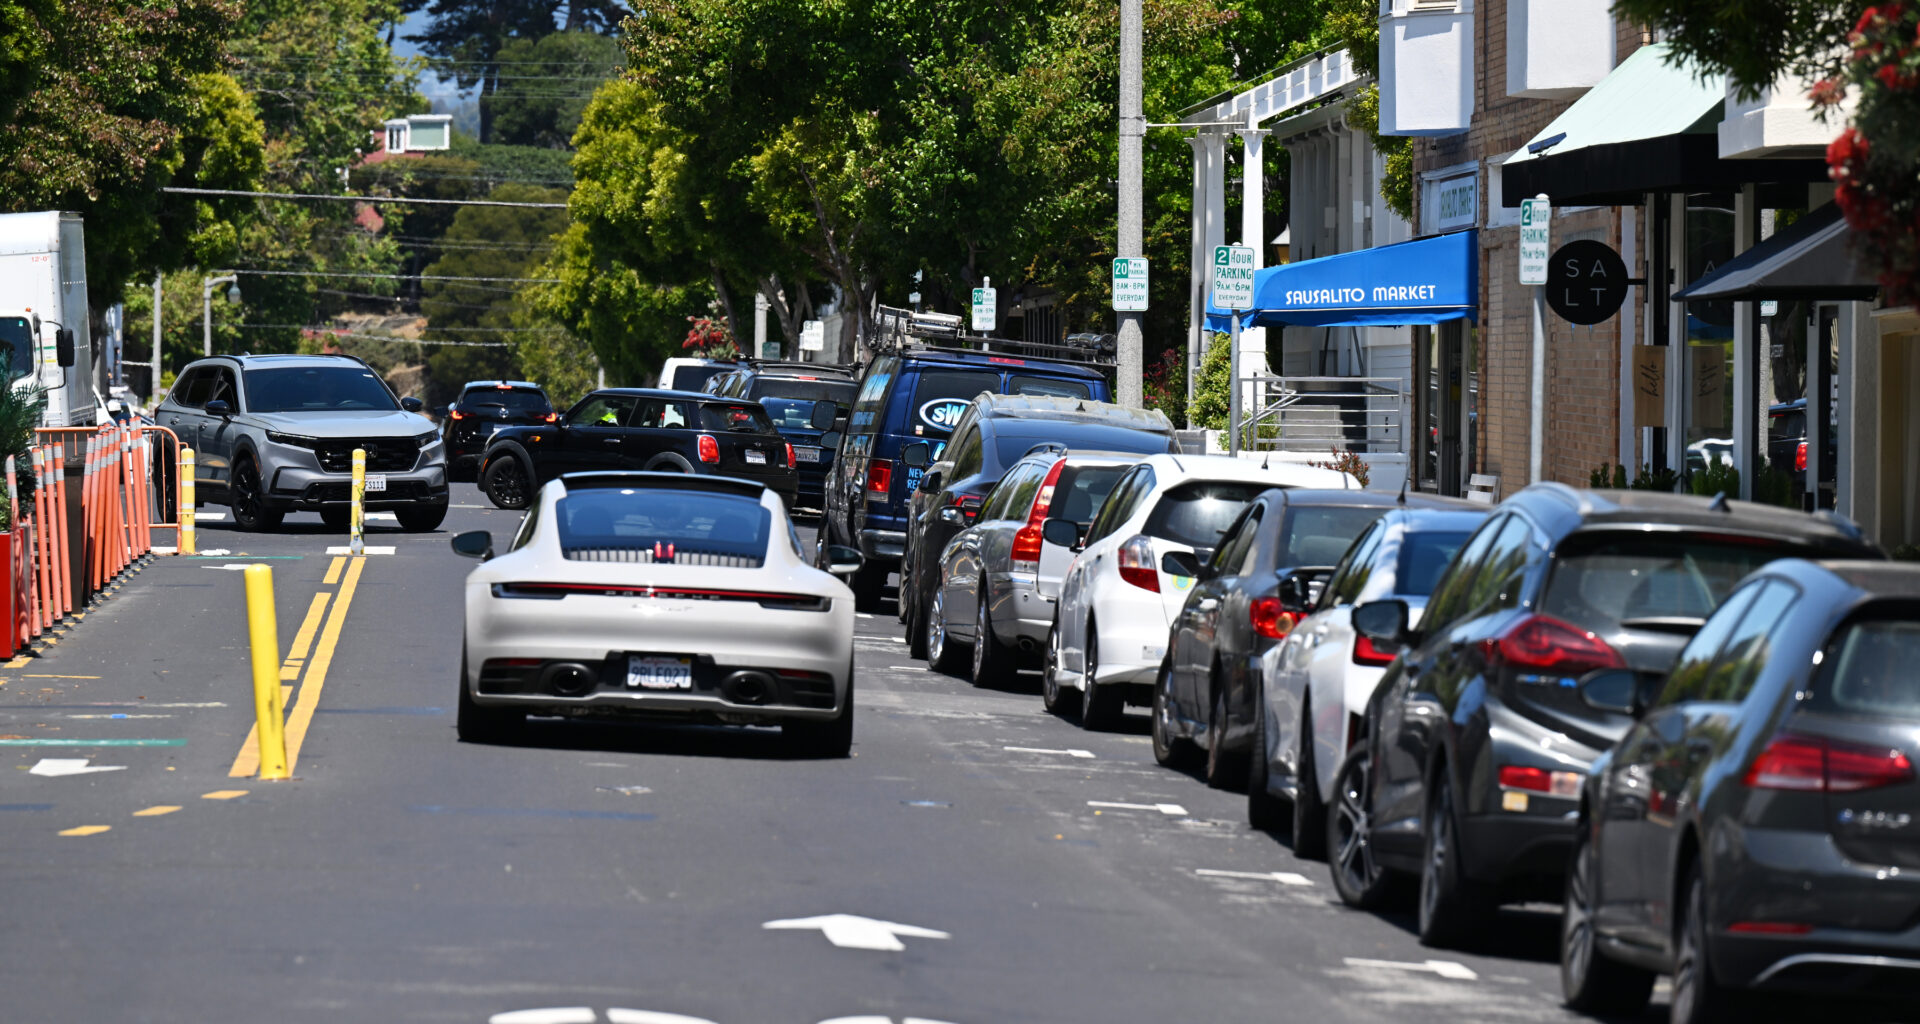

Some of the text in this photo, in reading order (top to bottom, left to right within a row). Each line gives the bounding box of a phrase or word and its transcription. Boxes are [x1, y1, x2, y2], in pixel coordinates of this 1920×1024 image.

[1523, 205, 1530, 223] 2
[1522, 229, 1547, 243] PARKING
[1217, 250, 1251, 264] 2 HOUR
[1115, 262, 1127, 275] 20
[1216, 267, 1252, 280] PARKING
[974, 292, 982, 302] 20
[1286, 285, 1436, 305] SAUSALITO MARKET
